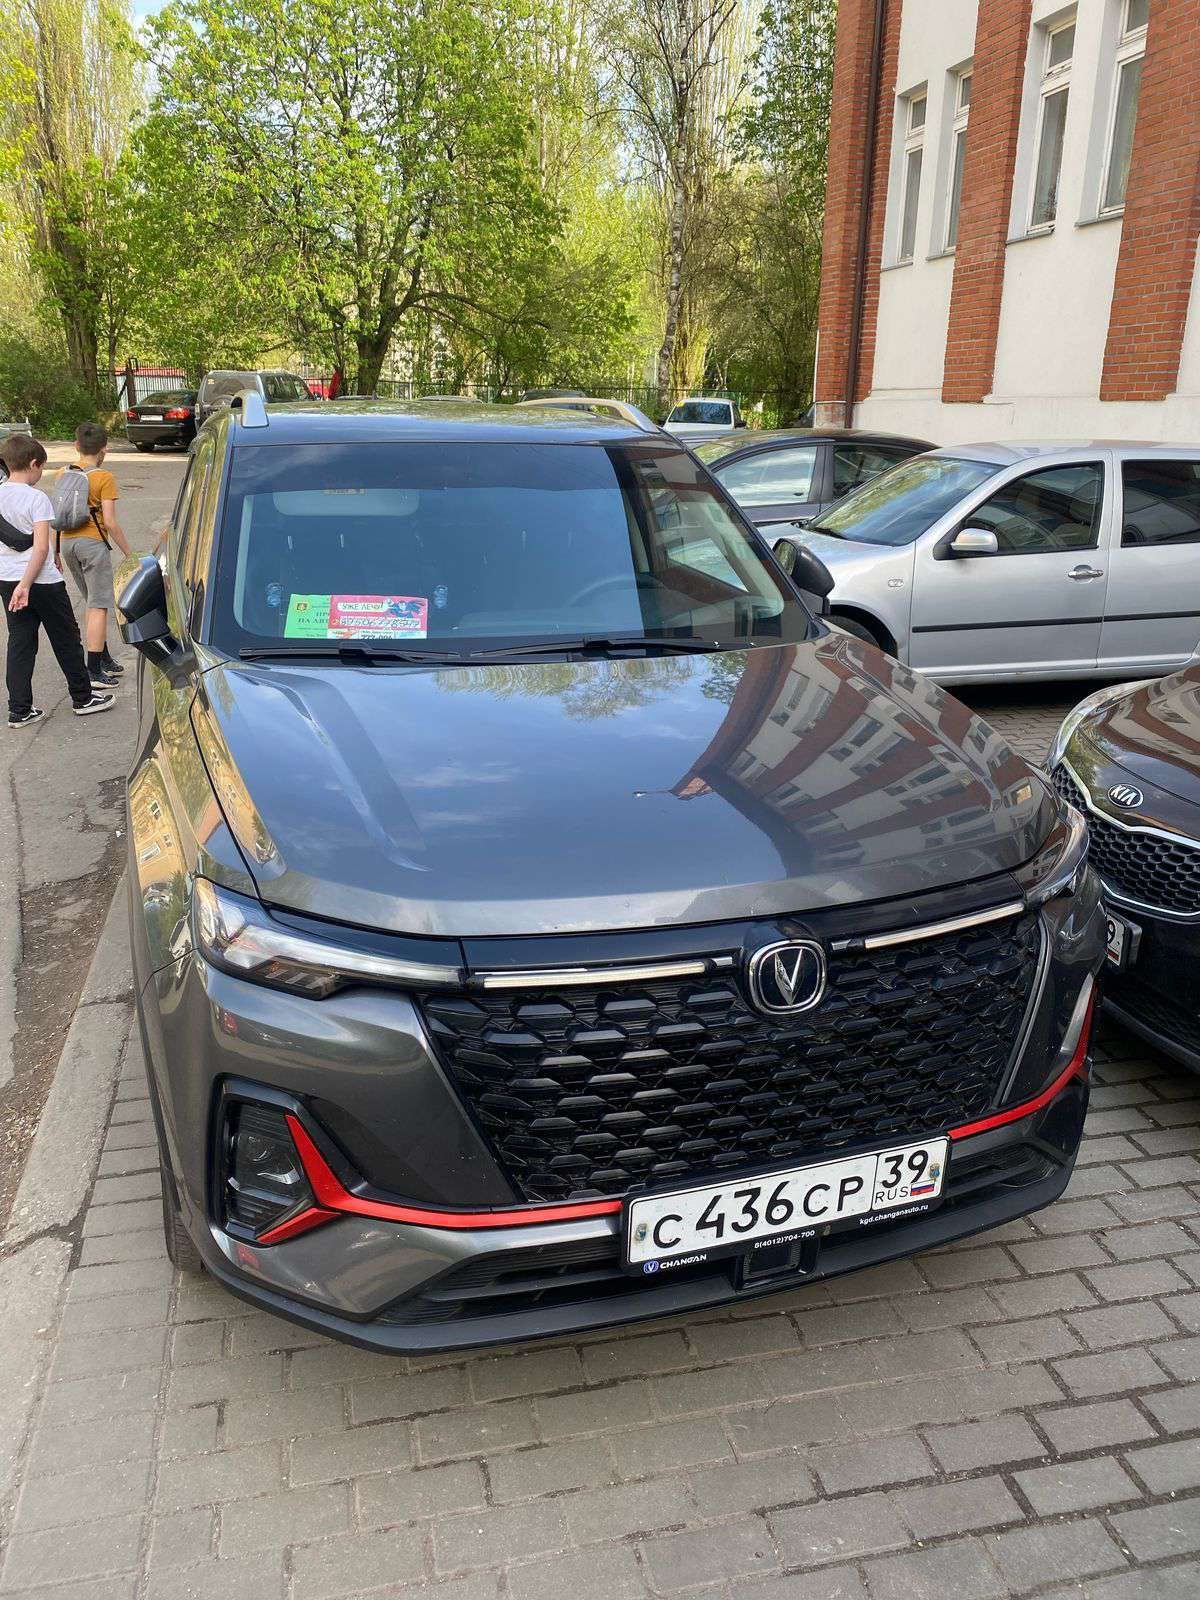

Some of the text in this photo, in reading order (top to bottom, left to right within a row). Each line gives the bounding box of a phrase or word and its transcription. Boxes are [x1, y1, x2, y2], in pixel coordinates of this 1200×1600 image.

[1110, 785, 1137, 805] KIA
[881, 1149, 929, 1189] 39
[875, 1186, 909, 1204] RUS
[859, 1204, 929, 1225] kgd.changanauto.ru
[754, 1229, 816, 1249] 8(4012)704-700
[660, 1254, 707, 1269] CHANGAN
